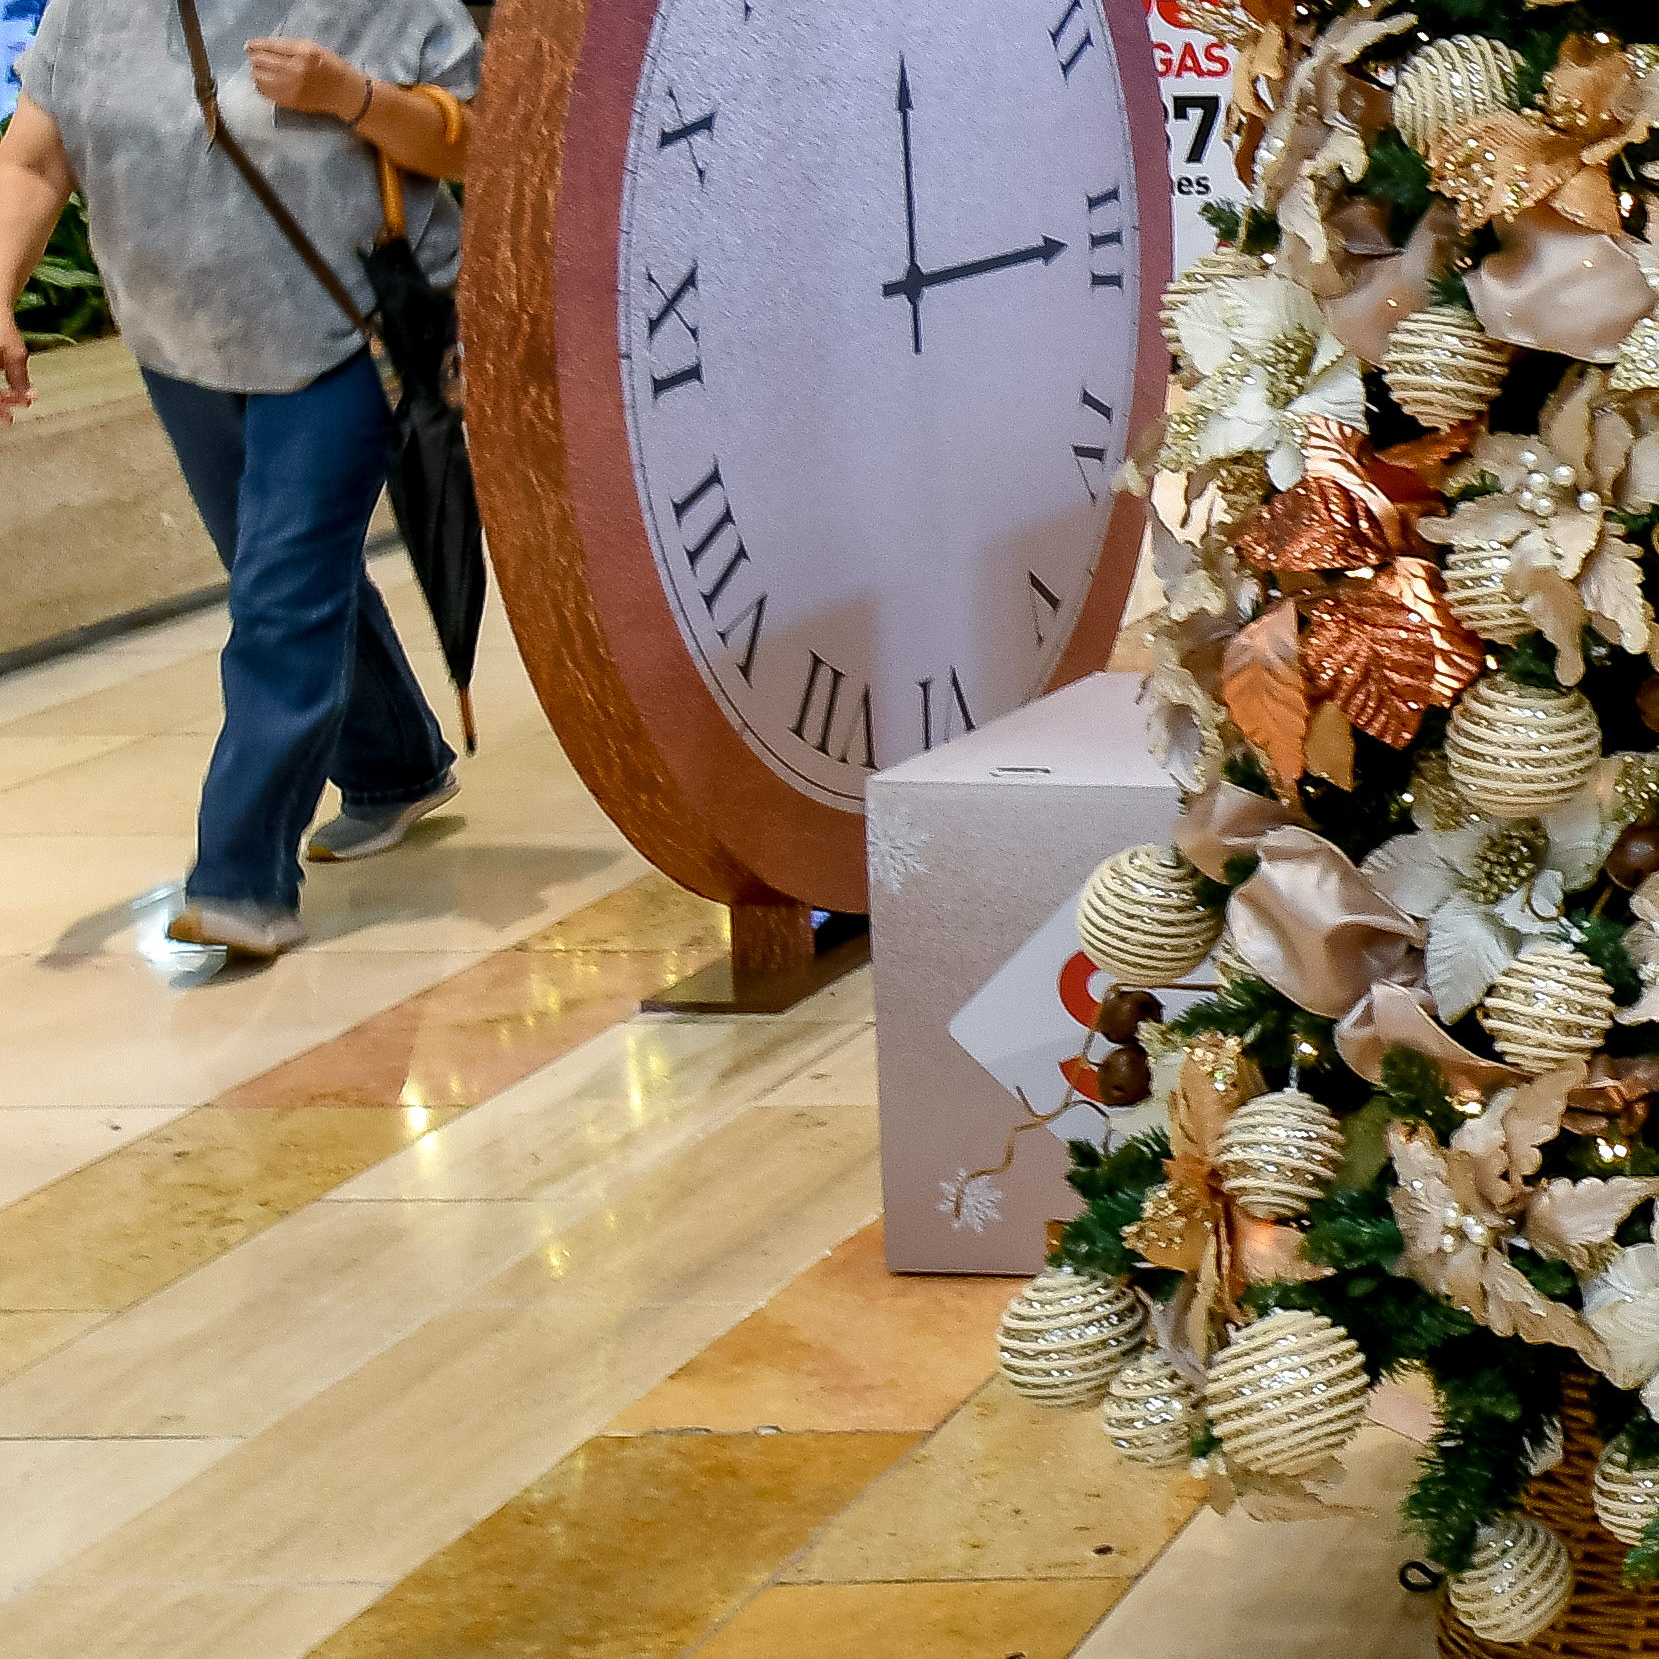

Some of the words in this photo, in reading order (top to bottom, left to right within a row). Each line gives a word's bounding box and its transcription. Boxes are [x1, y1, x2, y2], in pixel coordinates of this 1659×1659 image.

[658, 86, 716, 186] X
[1085, 184, 1125, 293] III
[643, 259, 705, 403] IX
[1071, 387, 1116, 504] IV
[1027, 569, 1062, 646] V
[788, 650, 880, 771] VII
